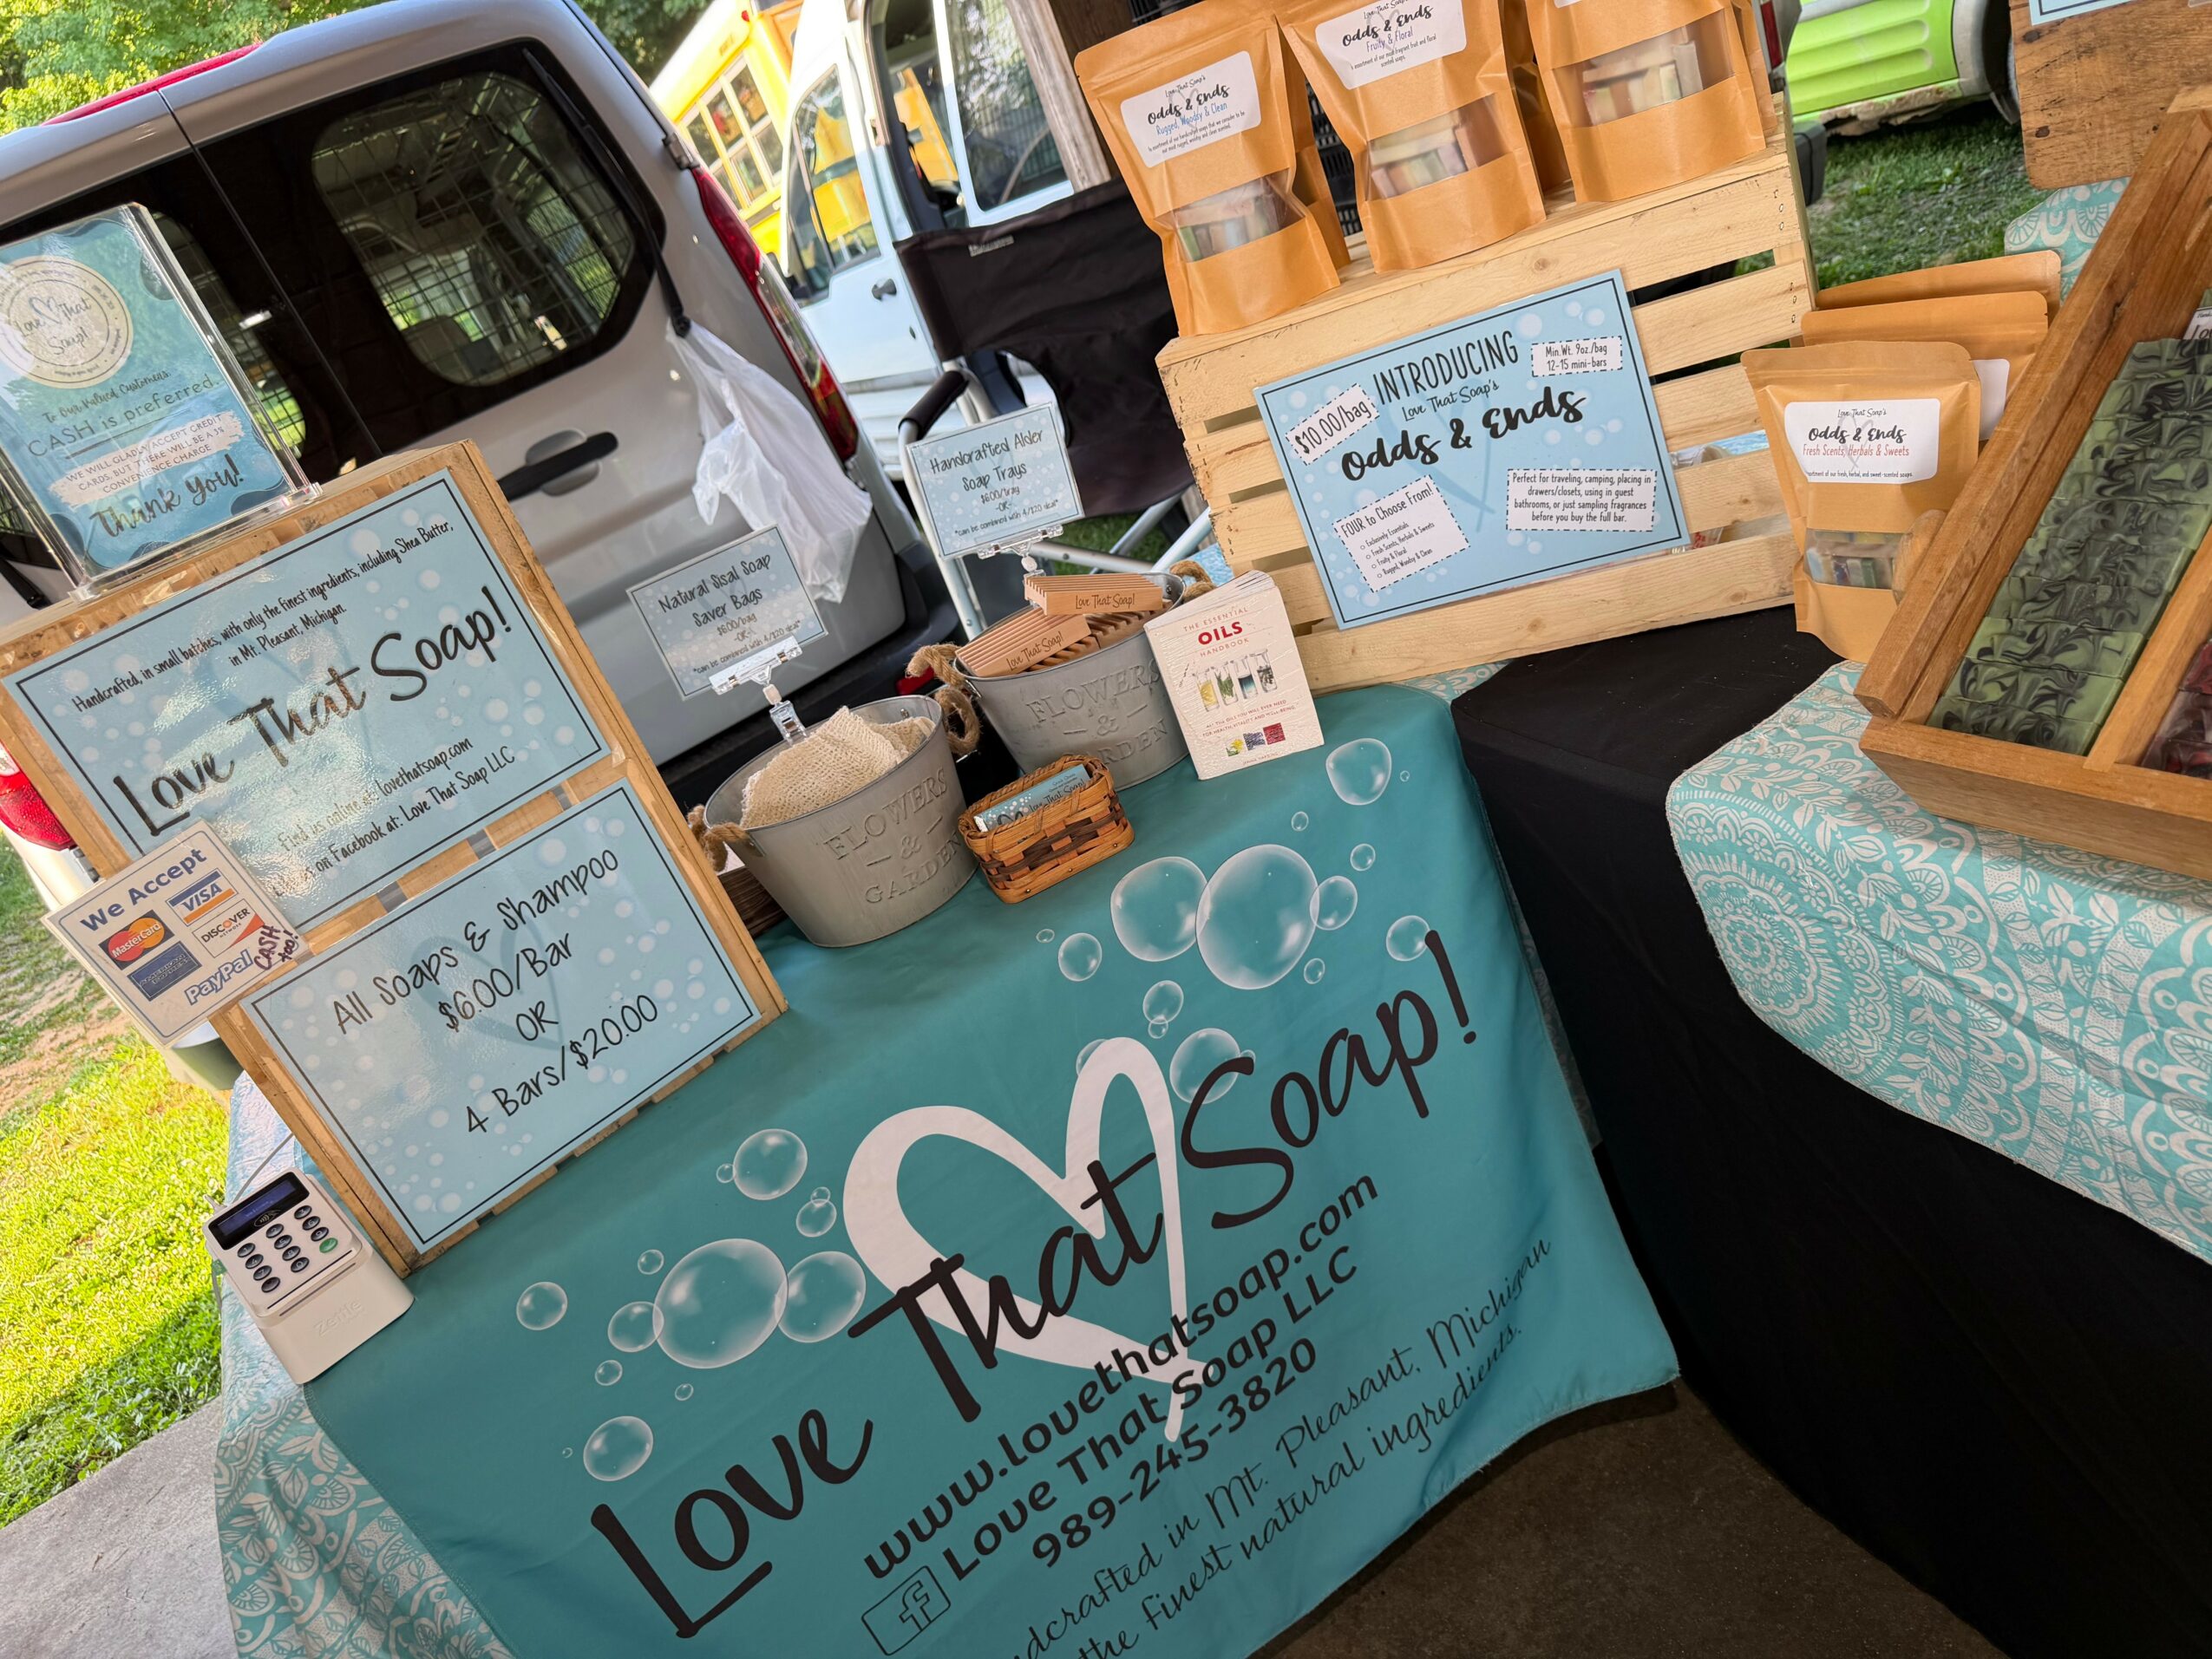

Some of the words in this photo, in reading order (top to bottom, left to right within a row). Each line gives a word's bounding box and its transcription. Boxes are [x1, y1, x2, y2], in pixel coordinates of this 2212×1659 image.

[1342, 25, 1380, 47] Odds
[1384, 20, 1392, 31] &
[1397, 4, 1434, 28] Ends
[1366, 38, 1386, 53] Fruity
[1388, 35, 1393, 44] &
[1394, 26, 1413, 42] Floral
[1148, 103, 1182, 124] Odds
[1186, 99, 1193, 110] &
[1196, 83, 1230, 106] Ends
[1155, 118, 1180, 136] Rugged,
[1180, 112, 1203, 126] Woodsy
[1204, 106, 1210, 116] &
[1211, 102, 1227, 114] Clean
[1373, 330, 1518, 405] INTRODUCING
[1548, 359, 1568, 371] 12-15
[1572, 356, 1607, 369] mini-bars
[28, 421, 95, 457] CASH
[101, 415, 117, 429] is
[123, 374, 219, 425] preferred.
[1295, 399, 1371, 454] $10.00/bag
[1402, 405, 1426, 421] Love
[1427, 391, 1457, 412] That
[1459, 380, 1499, 404] Soap's
[67, 470, 84, 482] WE
[86, 459, 111, 475] WILL
[113, 444, 148, 464] GLADLY
[152, 429, 187, 449] ACCEPT
[190, 414, 222, 434] CREDIT
[78, 475, 113, 491] CARDS,
[114, 465, 133, 478] BUT
[136, 454, 167, 470] THERE
[167, 441, 191, 457] WILL
[193, 434, 205, 444] BE
[214, 426, 225, 435] 3%
[930, 437, 1010, 474] Handcrafted
[1014, 429, 1043, 450] Alder
[1342, 430, 1442, 480] Odds
[1450, 418, 1472, 448] &
[1482, 386, 1586, 439] Ends
[1803, 444, 1820, 455] Fresh
[1823, 444, 1845, 457] Scents,
[1849, 444, 1874, 455] Herbals
[1876, 444, 1881, 455] &
[1884, 444, 1909, 455] Sweets
[1809, 426, 1850, 444] Odds
[1853, 428, 1862, 441] &
[1868, 425, 1907, 443] Ends
[102, 460, 172, 493] CONVENIENCE
[173, 443, 211, 464] CHARGE
[962, 473, 991, 492] Soap
[993, 462, 1027, 482] Trays
[1513, 473, 1536, 483] Perfect
[1540, 473, 1548, 483] for
[1552, 473, 1583, 486] traveling,
[1585, 474, 1615, 486] camping,
[1618, 474, 1641, 486] placing
[1645, 474, 1651, 483] in
[1528, 486, 1582, 498] drawers/closets,
[1585, 487, 1603, 499] using
[1606, 487, 1612, 496] in
[1615, 487, 1633, 499] guest
[89, 488, 180, 538] Thank
[1341, 518, 1365, 538] FOUR
[1365, 516, 1376, 526] to
[1376, 500, 1407, 520] Choose
[1405, 483, 1433, 505] From!
[1515, 499, 1551, 510] bathrooms,
[1562, 500, 1575, 511] just
[1578, 500, 1607, 512] sampling
[1611, 500, 1646, 512] fragrances
[1532, 512, 1554, 521] before
[1556, 513, 1568, 524] you
[1571, 512, 1583, 524] buy
[1586, 512, 1597, 521] the
[1600, 512, 1611, 521] full
[1613, 512, 1626, 522] bar.
[658, 579, 710, 613] Natural
[710, 565, 740, 590] Sisal
[742, 554, 771, 576] Soap
[692, 603, 727, 627] Saver
[730, 588, 762, 611] Bags
[72, 673, 143, 713] Handcrafted,
[141, 666, 154, 680] in
[153, 648, 183, 674] small
[182, 635, 221, 663] batches,
[221, 620, 243, 641] with
[242, 611, 267, 637] only
[263, 604, 281, 620] the
[278, 591, 309, 617] finest
[307, 567, 359, 604] ingredients,
[358, 548, 399, 578] including
[395, 536, 422, 552] Shea
[420, 520, 455, 543] Butter,
[229, 655, 239, 668] in
[239, 642, 259, 663] Mt.
[258, 623, 302, 653] Pleasant,
[300, 605, 348, 639] Michigan.
[1198, 621, 1243, 645] OILS
[1200, 638, 1249, 657] HANDBOOK
[113, 748, 234, 836] Love
[226, 664, 366, 767] That
[370, 587, 511, 702] Soap!
[375, 737, 473, 797] lovethatsoap.com
[316, 855, 334, 872] on
[328, 826, 387, 862] Facebook
[386, 816, 403, 833] at:
[398, 799, 431, 821] Love
[426, 781, 459, 805] That
[455, 767, 488, 790] Soap
[484, 746, 515, 773] LLC
[823, 767, 948, 860] FLOWERS
[898, 834, 922, 859] &
[80, 901, 125, 933] We
[128, 847, 207, 905] Accept
[181, 882, 223, 911] VISA
[110, 920, 162, 959] MasterCard
[200, 907, 251, 944] DISCOVER
[254, 924, 281, 970] CASH
[332, 992, 373, 1035] All
[372, 945, 458, 1006] Soaps
[464, 921, 491, 951] &
[496, 849, 618, 931] Shampoo
[183, 949, 254, 1005] PayPal
[438, 933, 573, 1033] $6.00/Bar
[515, 1000, 559, 1041] OR
[466, 1106, 489, 1133] 4
[492, 994, 658, 1118] Bars/$20.00
[591, 1406, 874, 1640] Love
[847, 1149, 1165, 1424] That
[1180, 929, 1478, 1230] Soap!
[863, 1175, 1378, 1579] www.lovethatsoap.com
[1164, 1514, 1200, 1548] in
[1204, 1462, 1269, 1529] Mt.
[1425, 1239, 1551, 1368] Michigan
[942, 1479, 1058, 1581] Love
[1056, 1391, 1168, 1486] That
[1170, 1317, 1278, 1412] Soap
[1282, 1245, 1358, 1323] LLC
[1032, 1336, 1317, 1568] 989-245-3820
[1141, 1543, 1233, 1630] finest
[1239, 1441, 1365, 1561] natural
[1368, 1323, 1522, 1453] ingredients.
